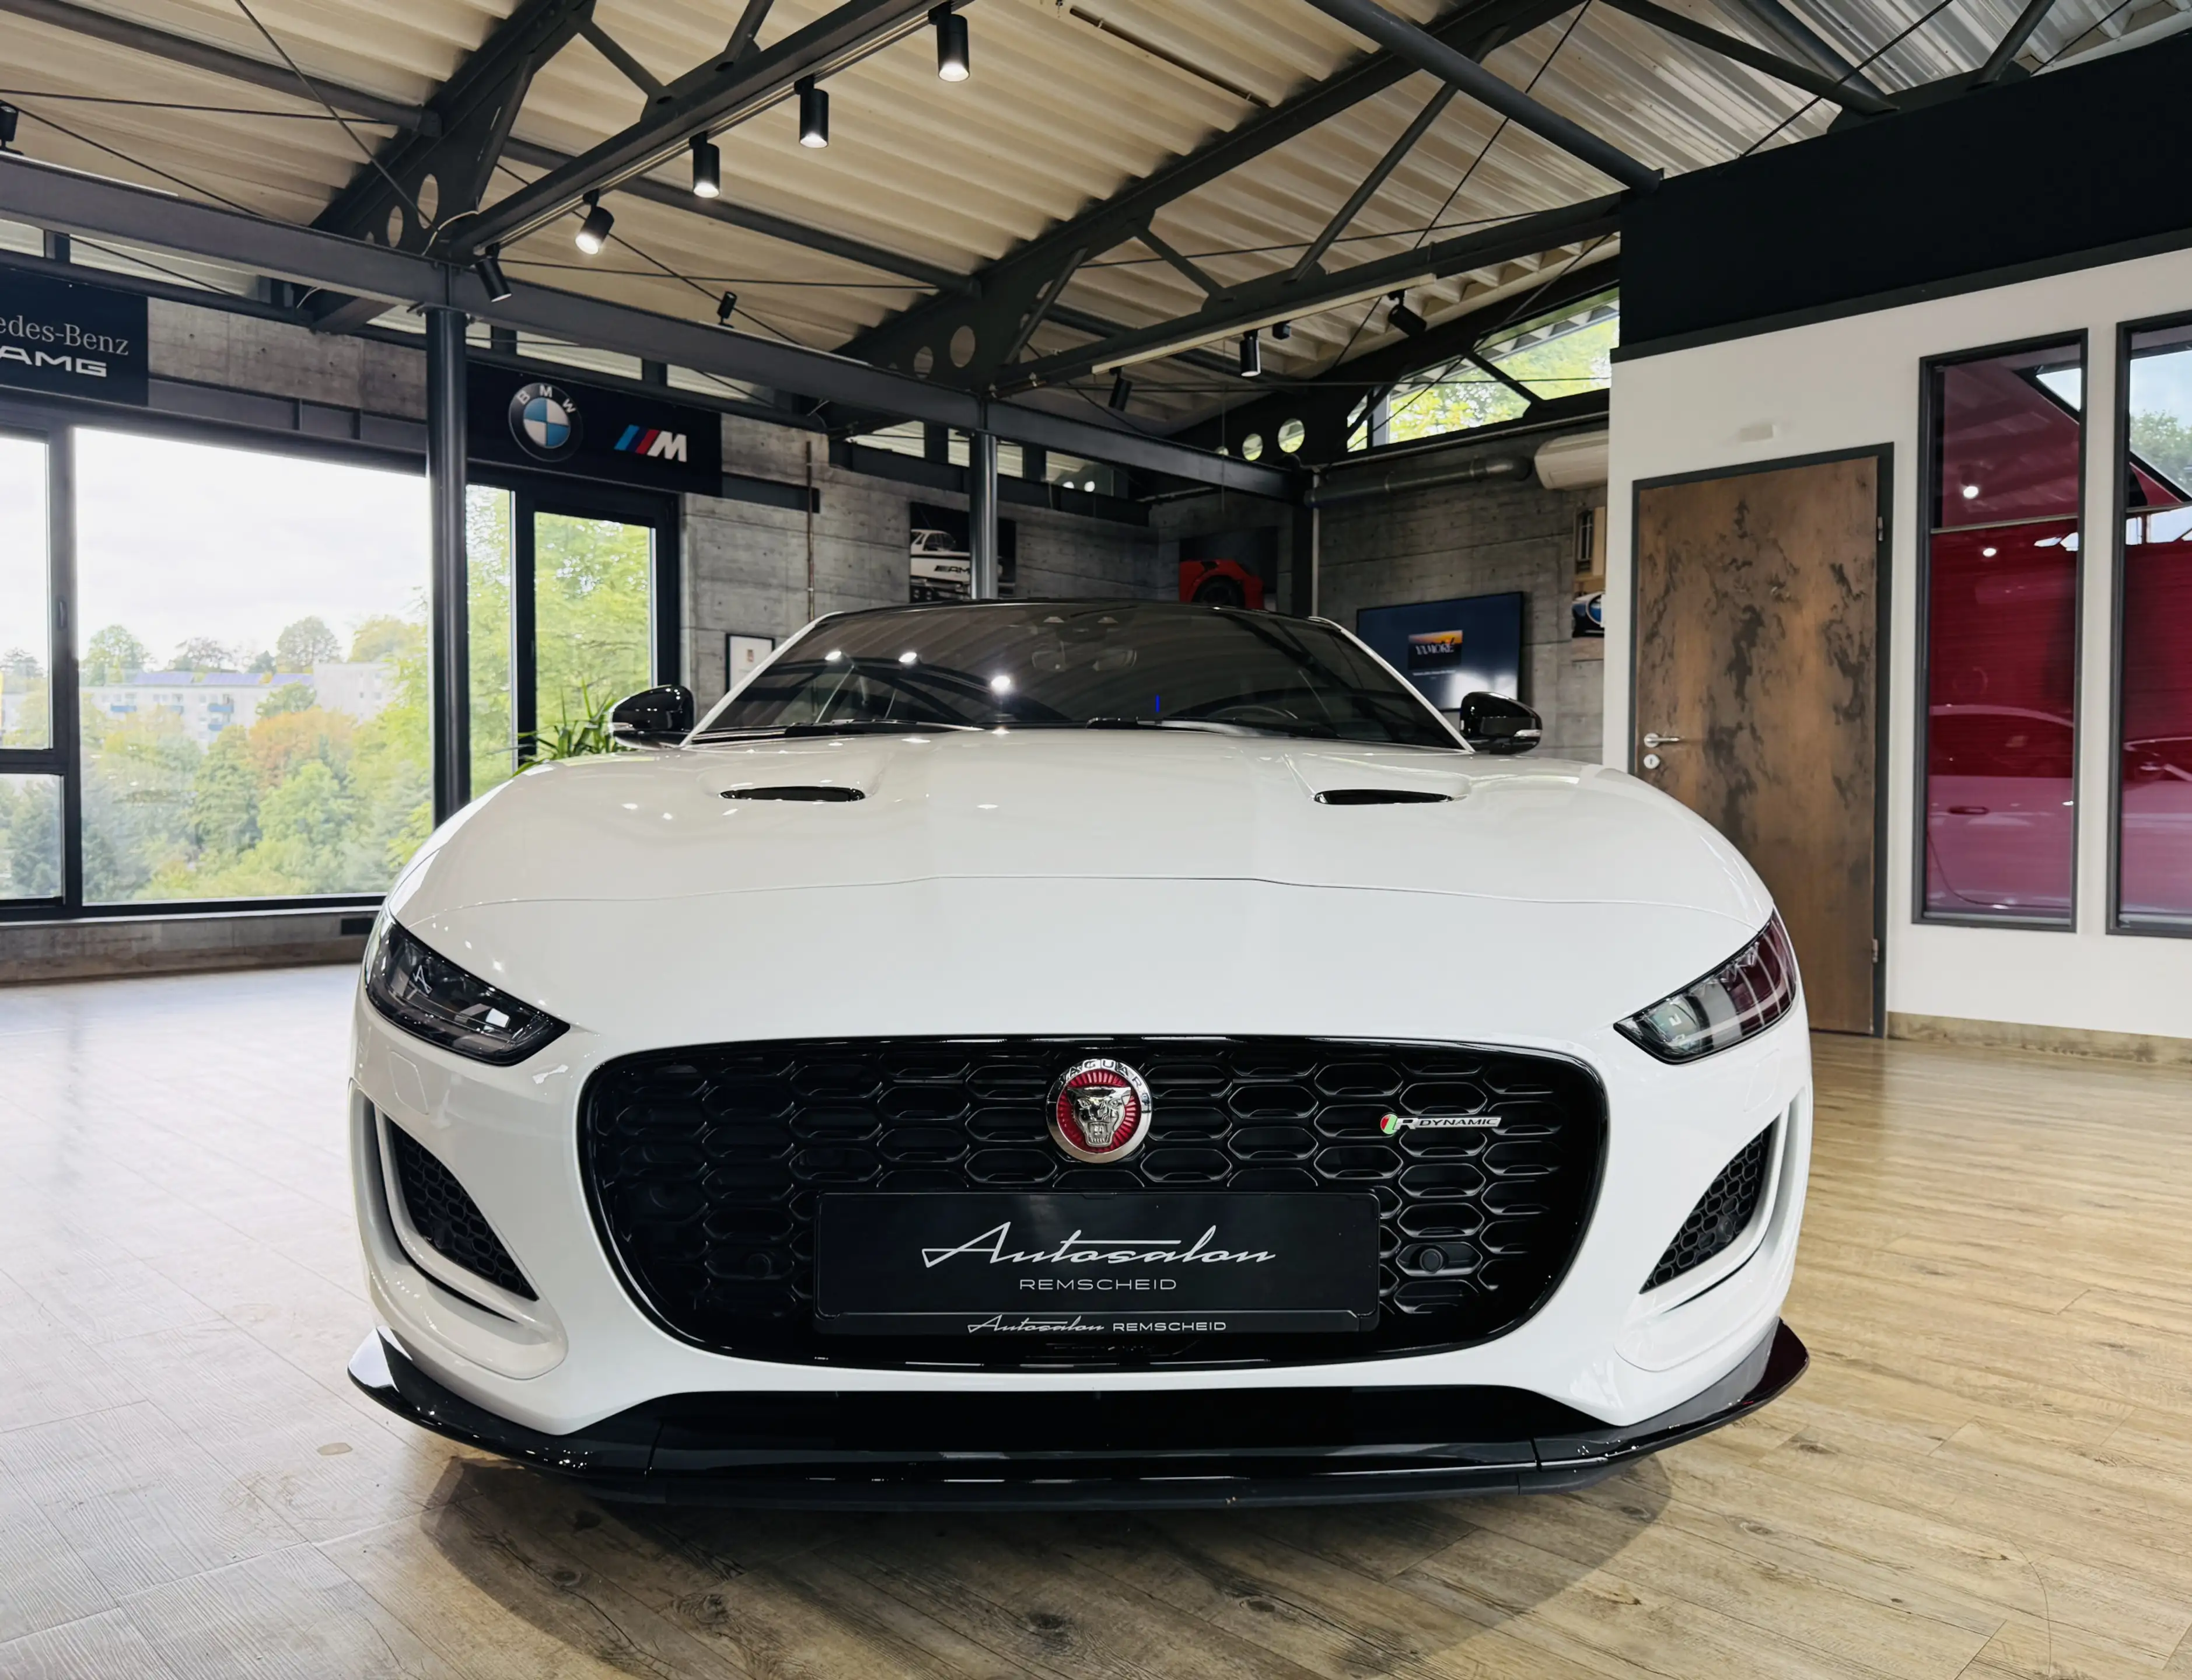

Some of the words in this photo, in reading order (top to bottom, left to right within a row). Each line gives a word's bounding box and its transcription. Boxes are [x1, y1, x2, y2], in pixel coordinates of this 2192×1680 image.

[0, 345, 107, 377] AMG
[516, 384, 576, 414] BMW
[647, 430, 687, 463] M
[1419, 1118, 1498, 1126] DYNAMIC
[921, 1220, 1276, 1268] Autosalon
[1019, 1278, 1178, 1291] REMSCHEID
[967, 1314, 1104, 1334] Autosalon
[1113, 1321, 1227, 1332] REMSCHEID
